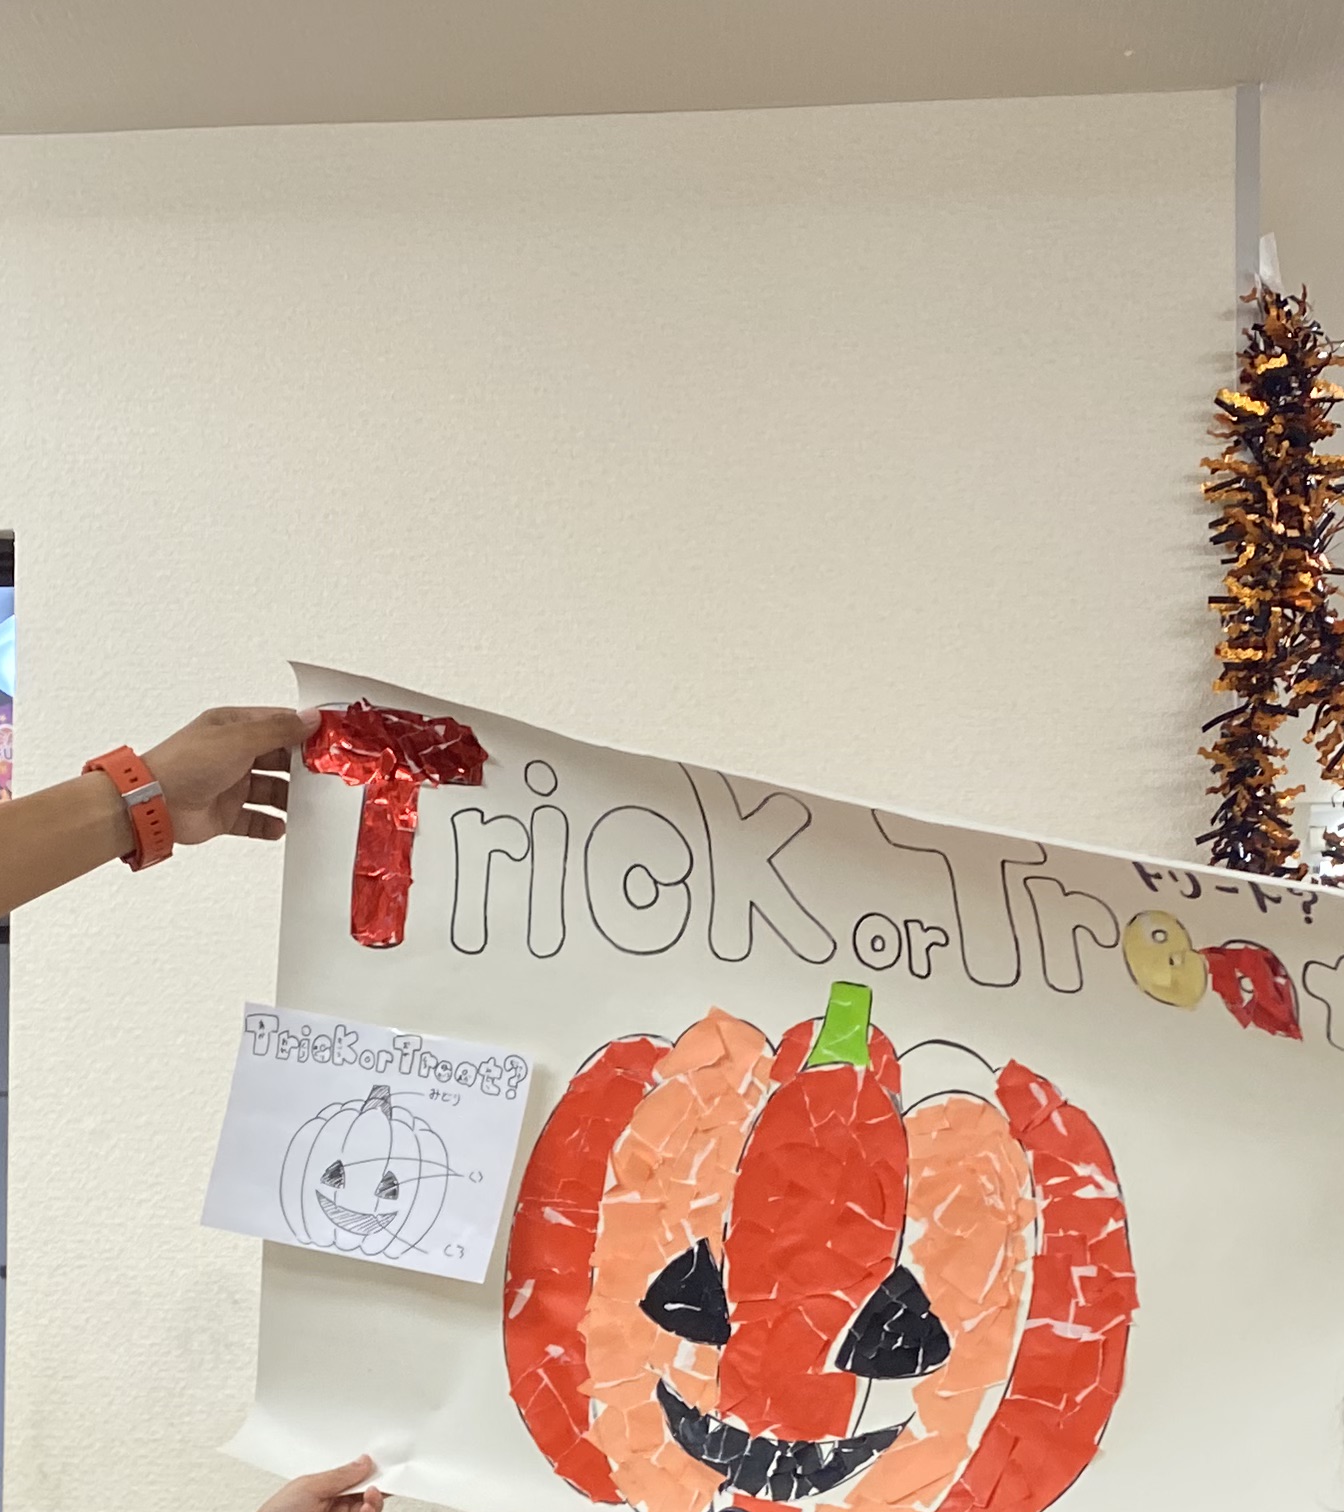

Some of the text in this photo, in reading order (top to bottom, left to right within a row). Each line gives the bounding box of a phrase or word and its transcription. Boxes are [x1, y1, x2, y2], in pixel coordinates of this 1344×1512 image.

[303, 697, 836, 964] Trick
[852, 912, 949, 979] or
[245, 1013, 529, 1100] Trick or Treat?
